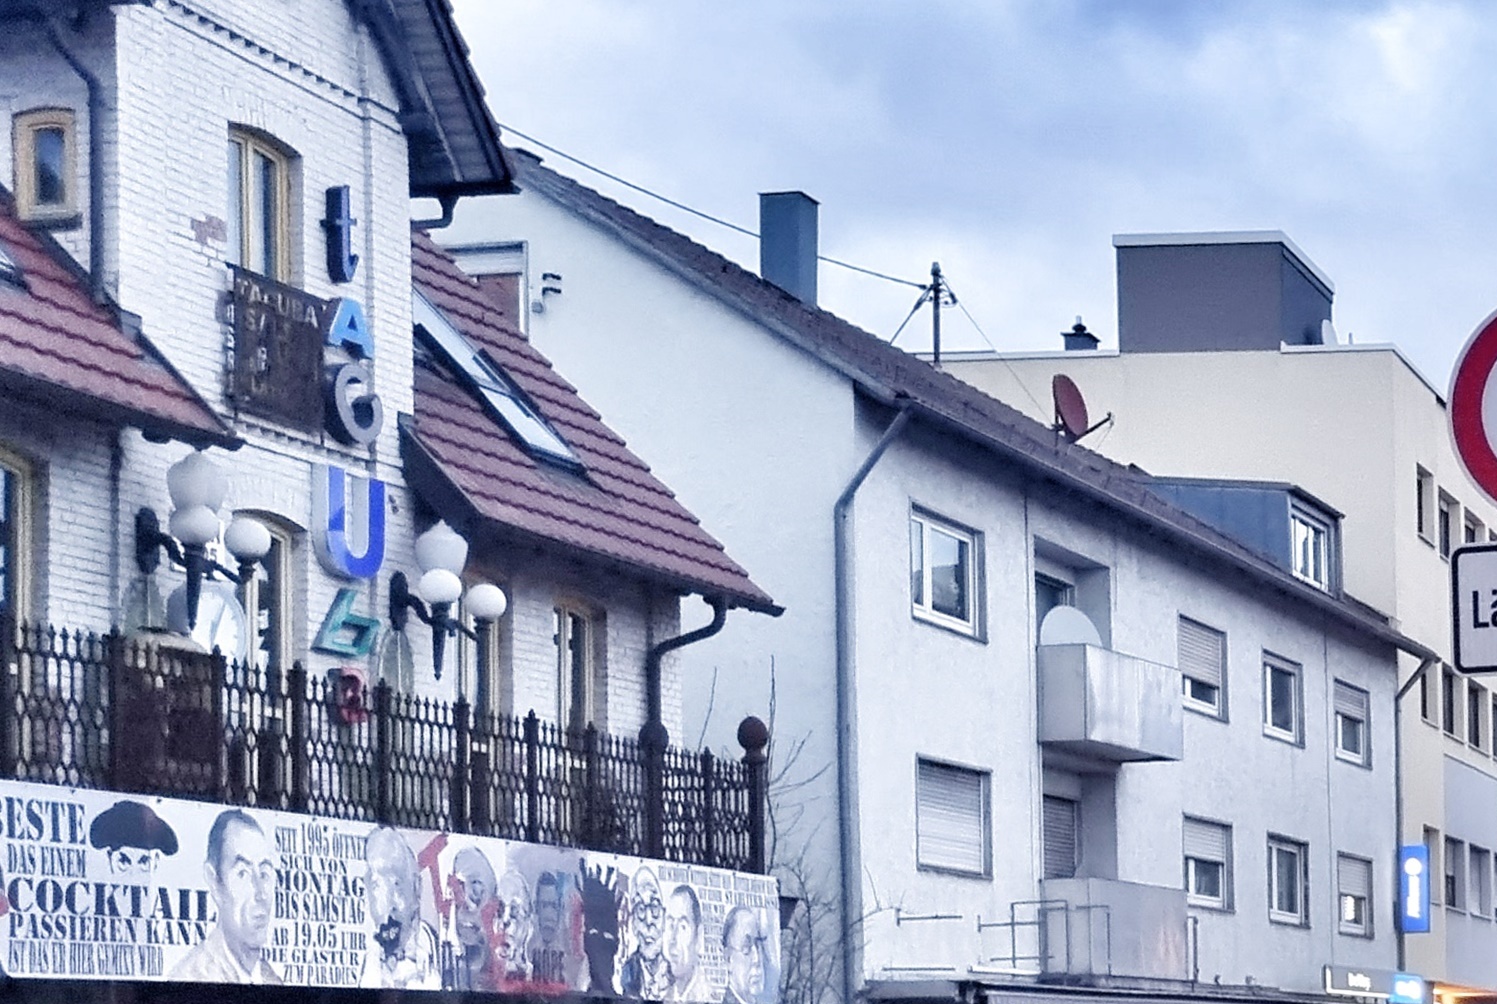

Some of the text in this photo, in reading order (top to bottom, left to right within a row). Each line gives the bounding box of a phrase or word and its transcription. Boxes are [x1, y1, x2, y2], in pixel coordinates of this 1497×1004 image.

[0, 796, 86, 844] ESTE
[275, 825, 297, 855] SEIT
[301, 823, 330, 858] 1995
[7, 843, 87, 879] DAS EINEM
[280, 854, 348, 876] SICH VON
[7, 876, 218, 923] COCKTAIL
[275, 869, 366, 899] MONTAG
[275, 891, 366, 925] BIS SAMSTAG
[9, 911, 208, 947] PASSIEREN KANN
[272, 921, 367, 952] AB 19.05 UHR
[8, 939, 25, 974] IST
[261, 947, 288, 964] DIE
[283, 964, 359, 985] ZUM PARADIES
